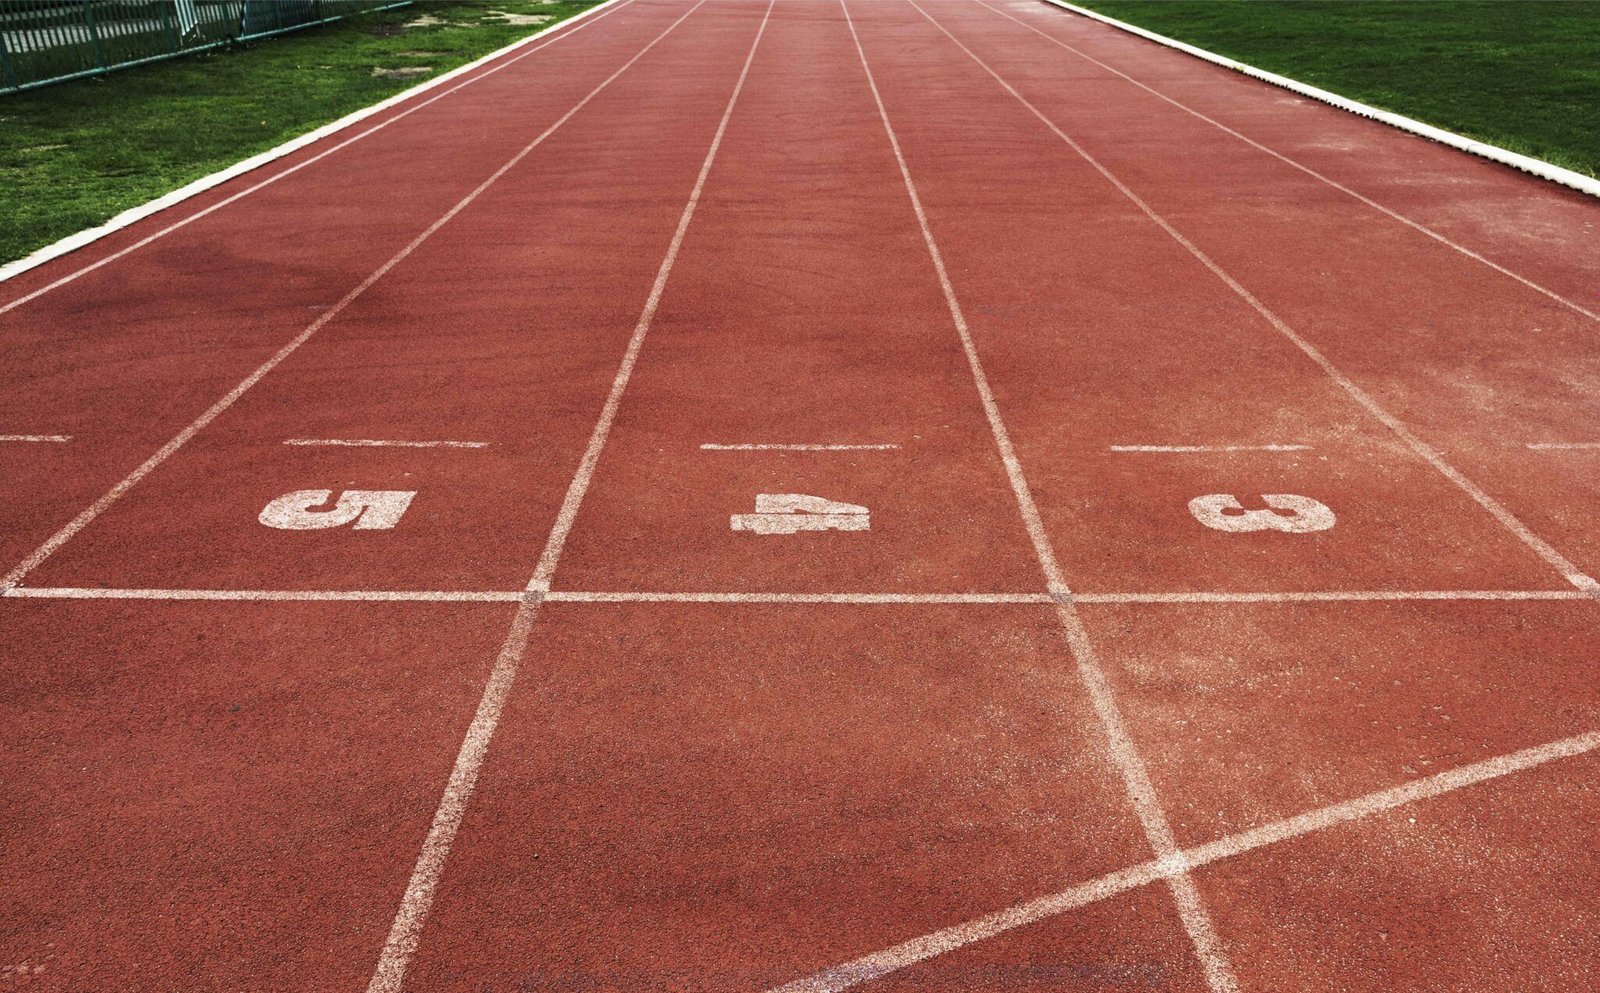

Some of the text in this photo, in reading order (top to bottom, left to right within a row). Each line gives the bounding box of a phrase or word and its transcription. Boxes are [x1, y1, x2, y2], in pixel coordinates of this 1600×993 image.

[258, 490, 416, 530] 5
[731, 493, 870, 535] 4
[1188, 493, 1336, 534] 3
